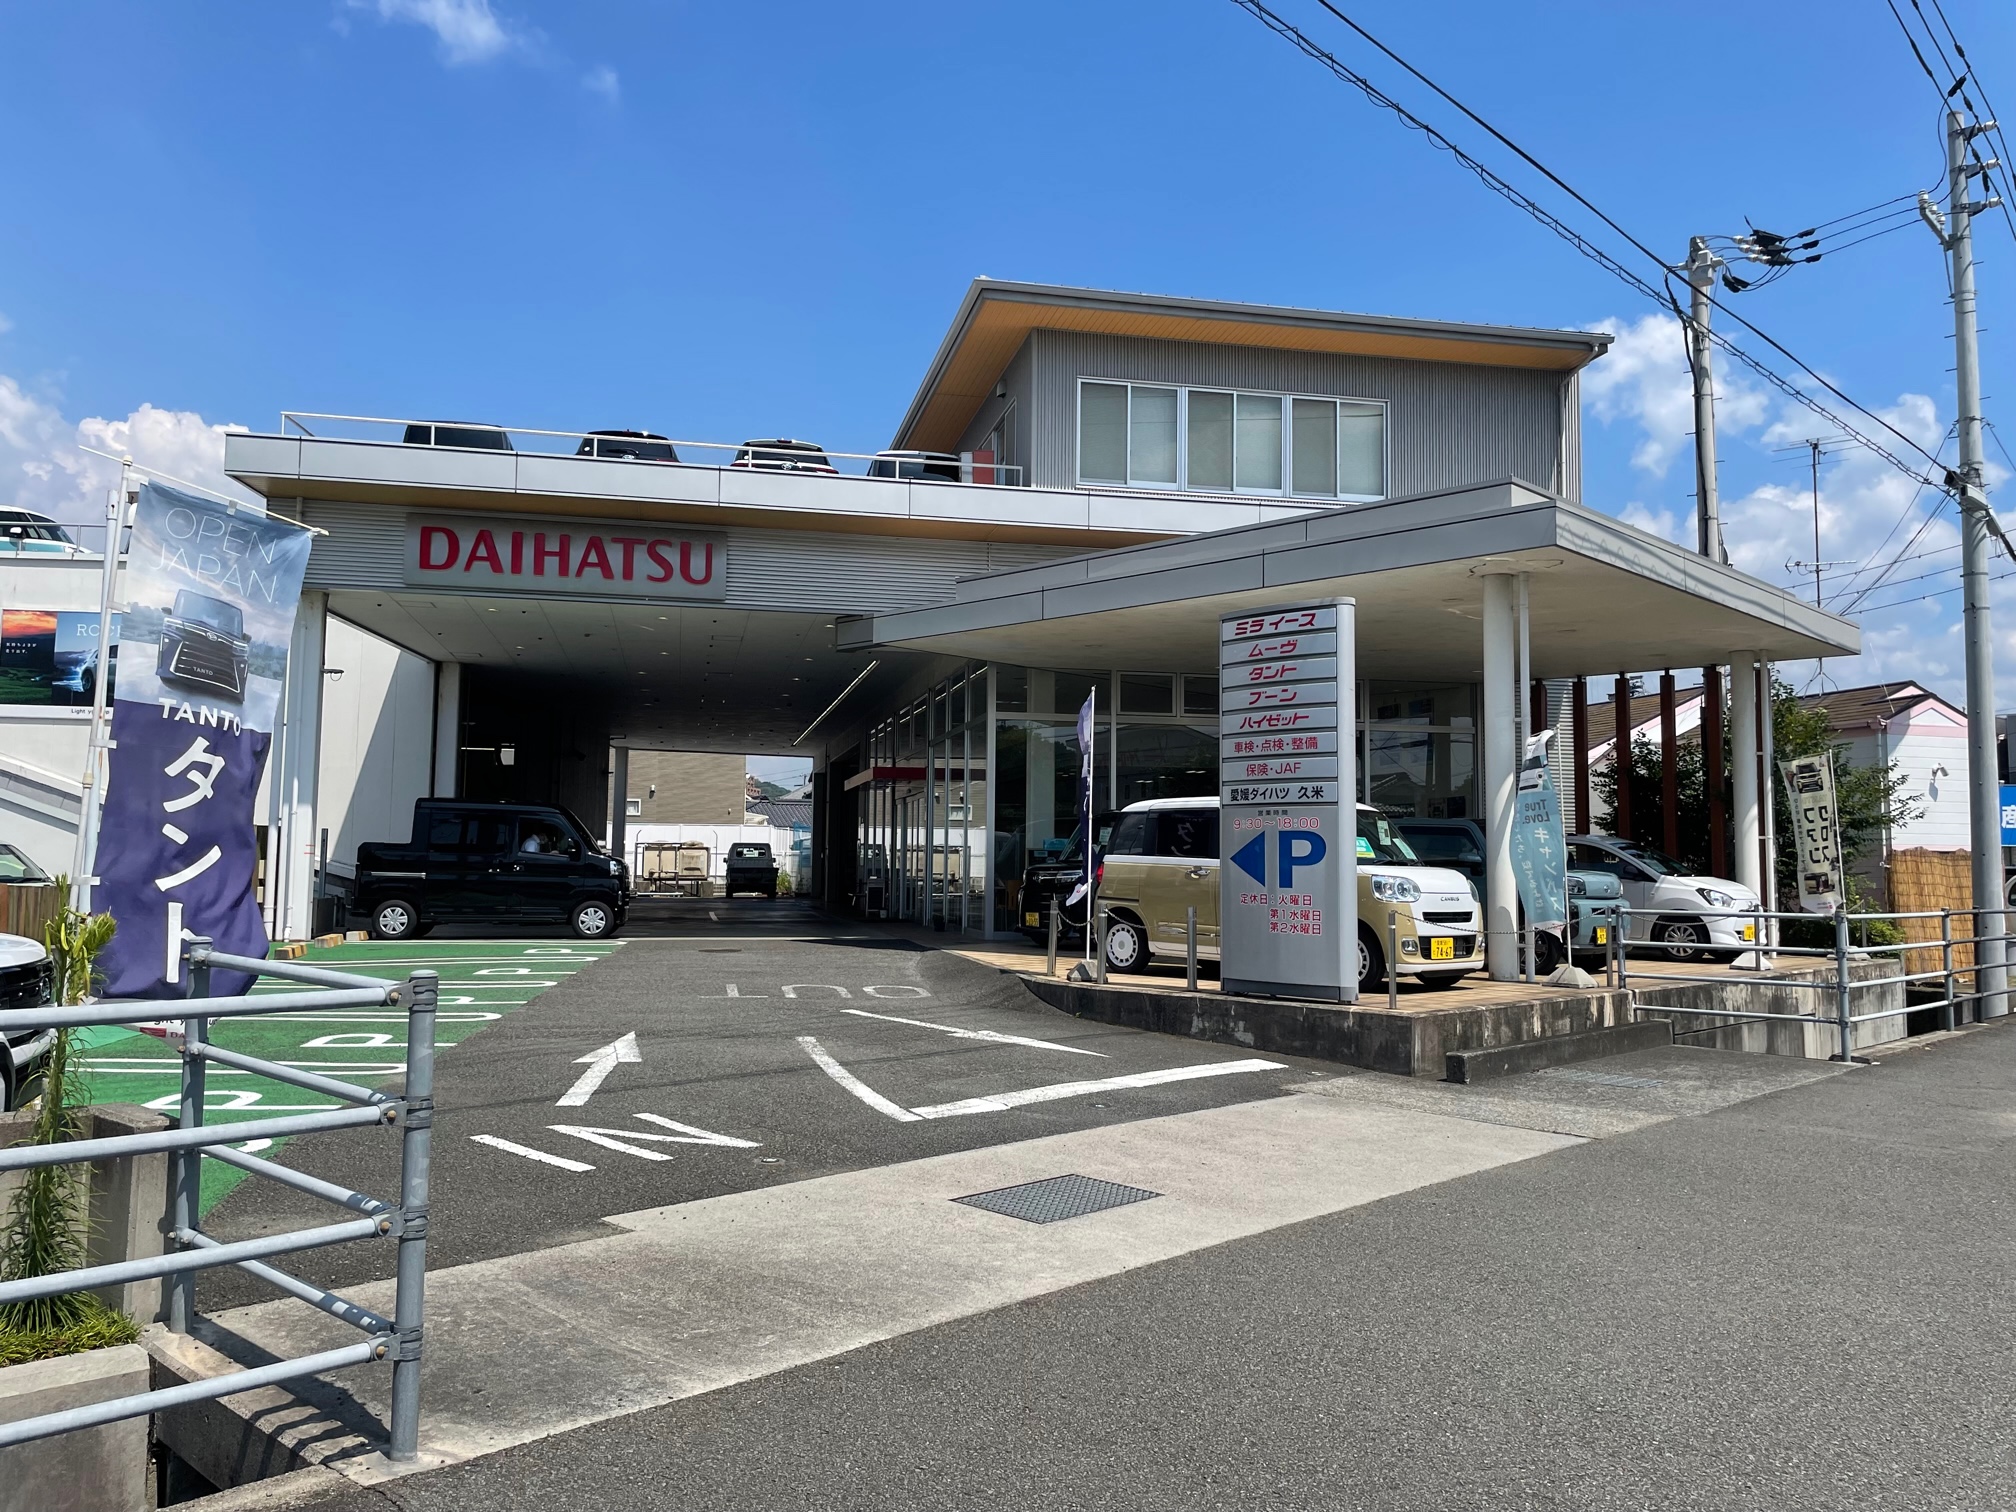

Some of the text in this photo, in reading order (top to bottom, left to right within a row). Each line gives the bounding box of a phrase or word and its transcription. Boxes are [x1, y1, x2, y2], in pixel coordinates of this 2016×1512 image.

[165, 507, 277, 565] OPEN
[419, 525, 713, 586] DAIHATSU
[1248, 639, 1298, 657] ムーヴ
[192, 666, 214, 676] TANTO
[1248, 664, 1297, 681] タント
[1248, 688, 1298, 705] ブーン
[159, 697, 242, 737] TANTO
[1239, 712, 1310, 729] ハイゼット
[1233, 736, 1318, 753] 車検・点検・整備
[1245, 762, 1302, 777] 保険・JAF
[1230, 785, 1325, 801] 愛媛ダイハツ 久米
[154, 735, 226, 984] タント
[1278, 830, 1327, 889] P
[1269, 908, 1322, 922] 第1水曜日
[1269, 922, 1322, 935] 第2水曜日
[698, 983, 932, 999] OUT
[469, 1112, 764, 1173] IN
